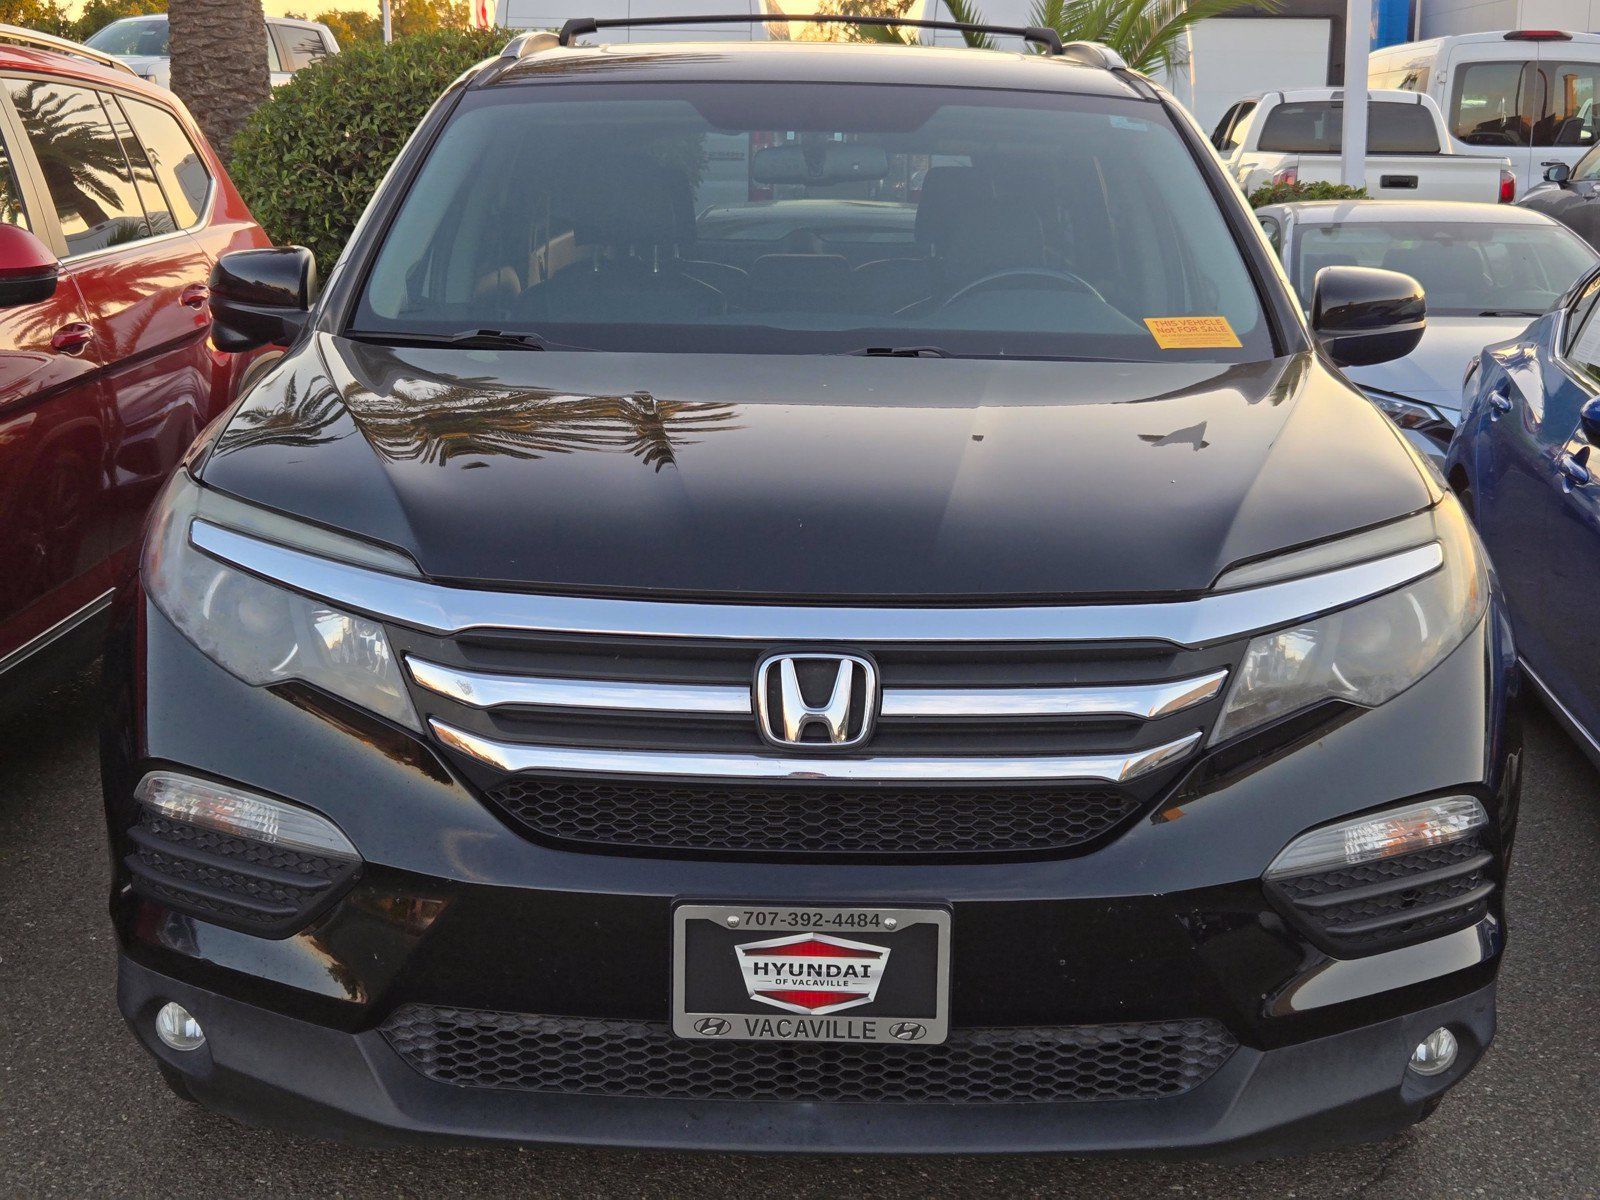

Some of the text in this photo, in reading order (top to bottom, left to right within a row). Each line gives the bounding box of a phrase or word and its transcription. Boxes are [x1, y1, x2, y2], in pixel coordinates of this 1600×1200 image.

[743, 911, 880, 928] 707-392-4484
[753, 962, 871, 978] HYUNDAI
[775, 978, 849, 987] OF VACAVILLE
[744, 1018, 876, 1040] VACAVILLE
